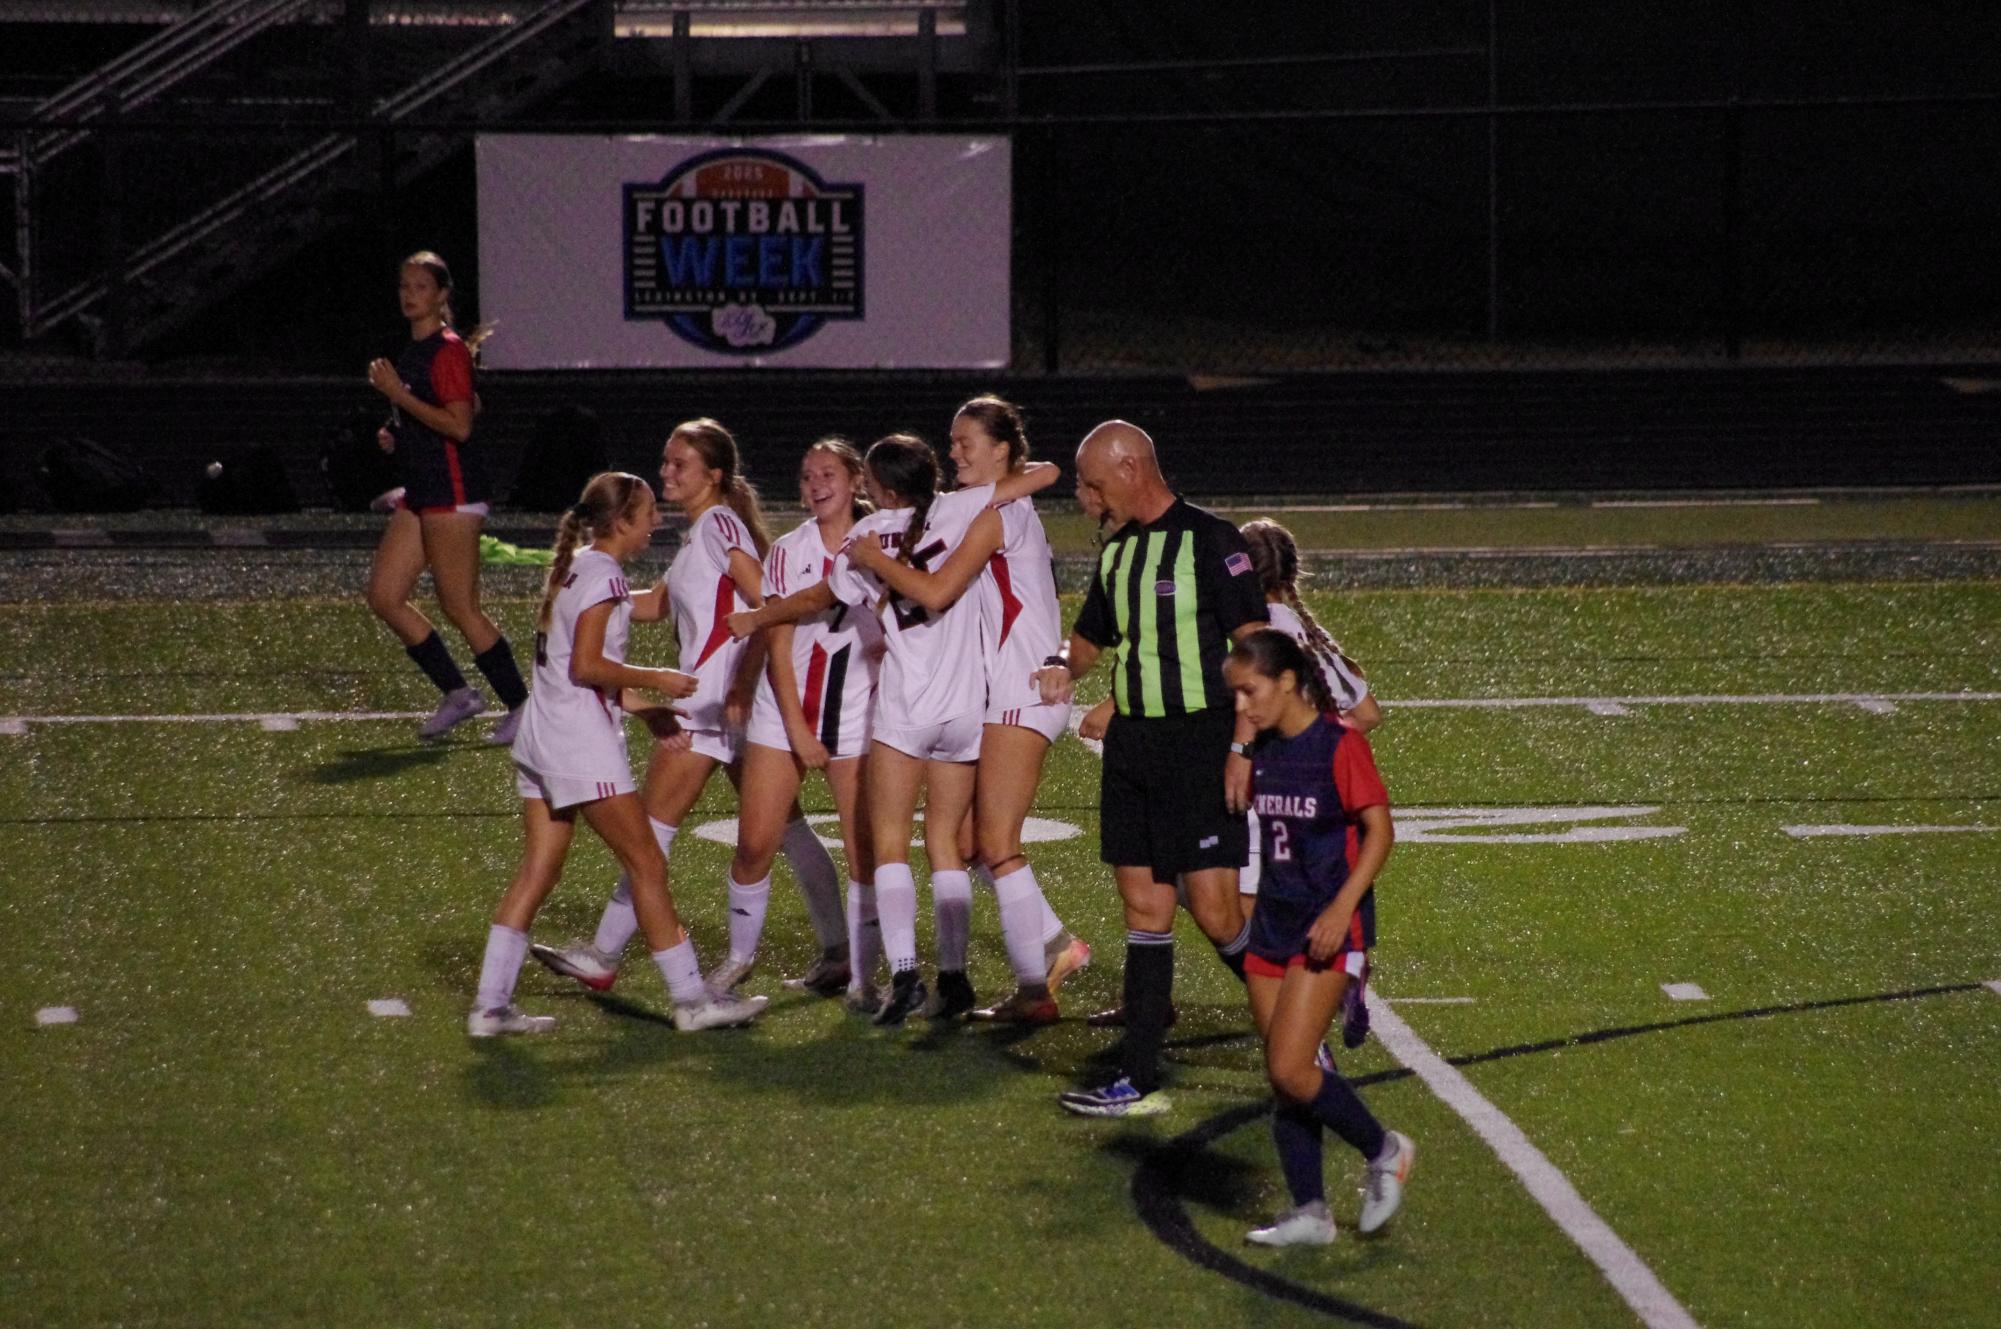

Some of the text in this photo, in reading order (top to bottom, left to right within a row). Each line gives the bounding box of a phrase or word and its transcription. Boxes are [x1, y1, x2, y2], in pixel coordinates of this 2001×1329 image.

[637, 201, 850, 233] FOOTBALL
[660, 234, 825, 288] WEEK
[1271, 820, 1292, 861] 2
